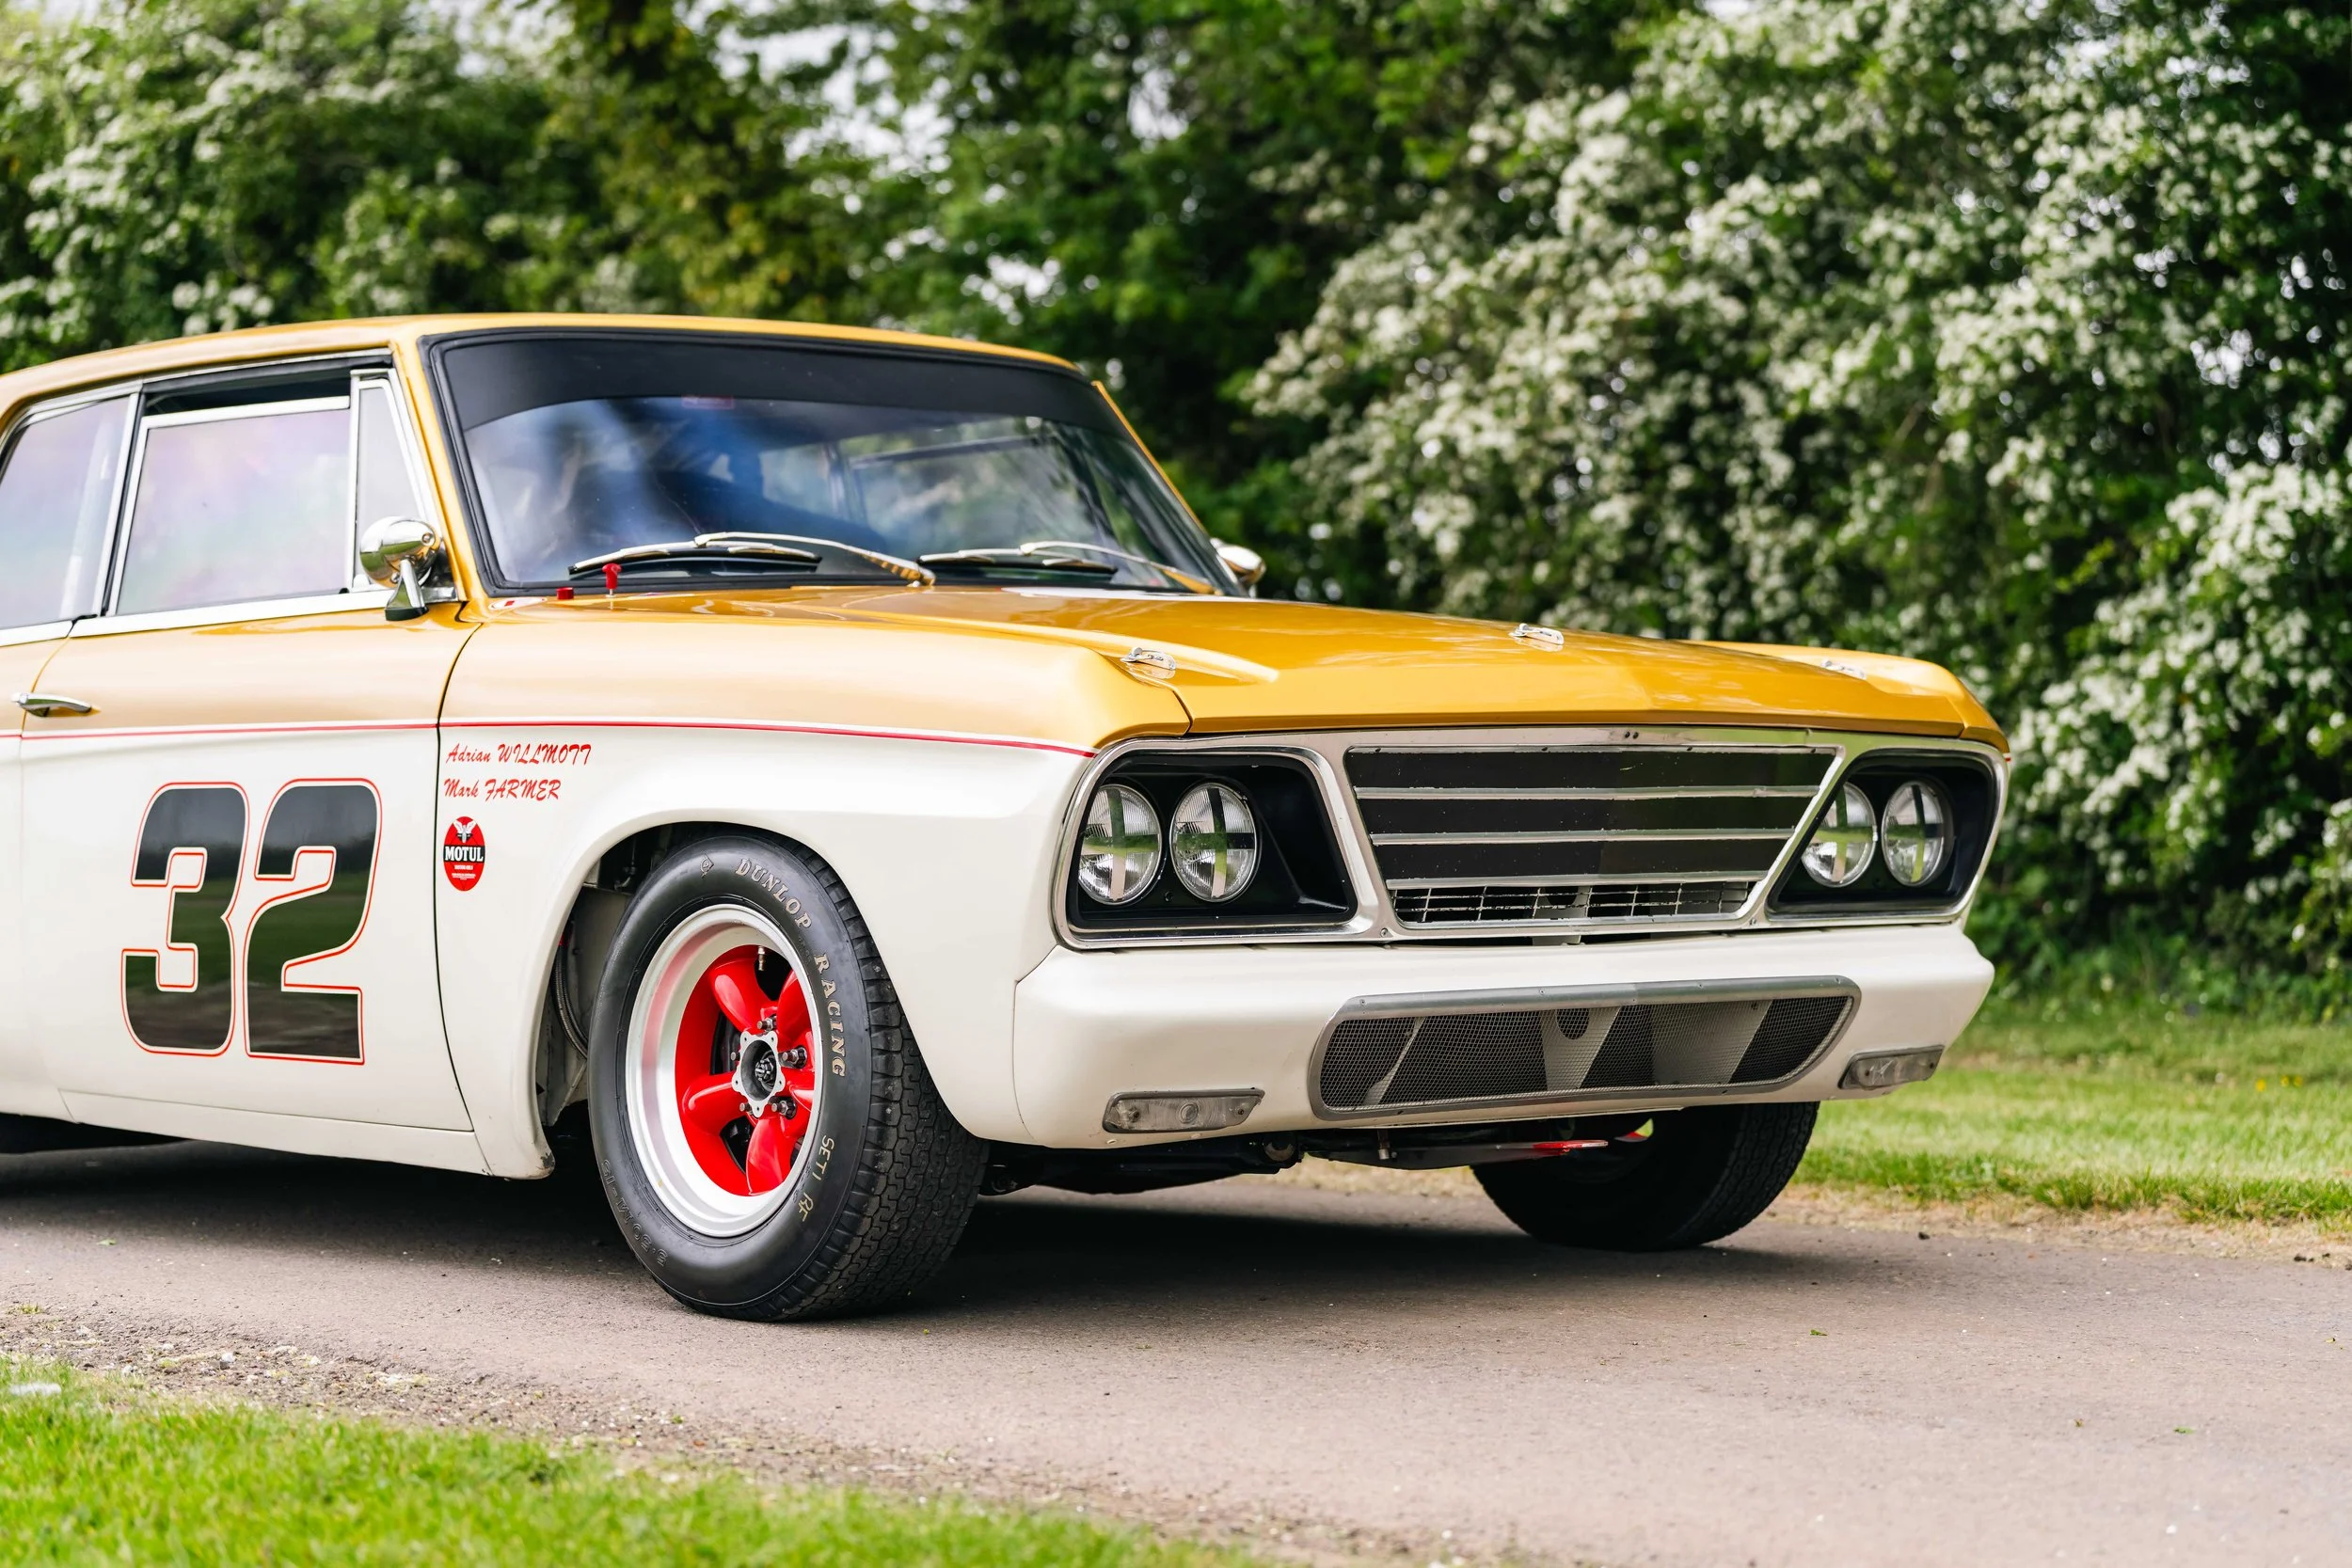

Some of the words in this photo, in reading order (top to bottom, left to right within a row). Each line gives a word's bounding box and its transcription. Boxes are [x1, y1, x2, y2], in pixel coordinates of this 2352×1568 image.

[446, 742, 491, 764] Adrian
[497, 743, 592, 766] WILLMOTT
[443, 778, 480, 798] Mark
[484, 779, 562, 801] FARMER
[444, 846, 484, 862] MOTUL
[120, 777, 383, 1066] 32
[735, 857, 812, 928] DUNLOP
[813, 953, 846, 1077] RACING
[797, 1192, 815, 1223] RF
